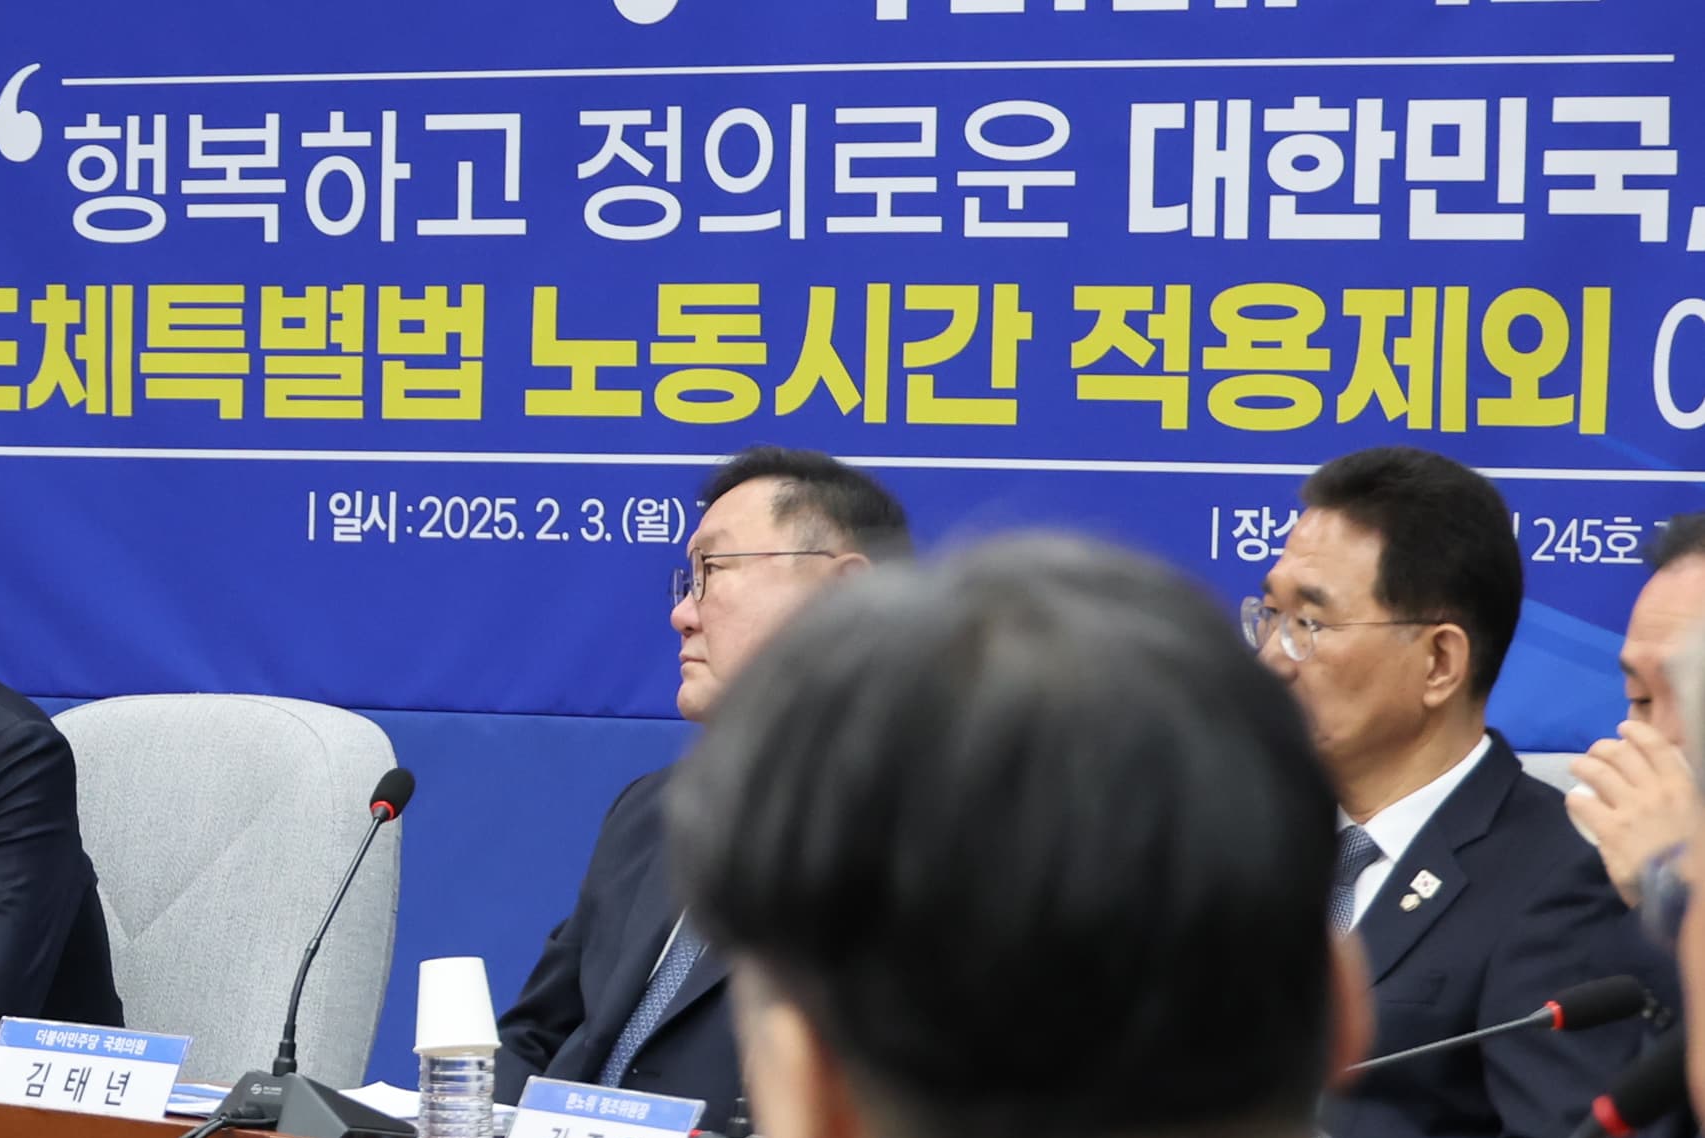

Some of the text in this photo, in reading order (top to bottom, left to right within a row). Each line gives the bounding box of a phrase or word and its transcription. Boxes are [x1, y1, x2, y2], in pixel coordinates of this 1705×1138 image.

[577, 100, 1076, 241] 정의로운
[524, 283, 1033, 425] 노동시간
[1070, 282, 1611, 435] 적용제외
[622, 497, 686, 544] (월)
[1531, 516, 1644, 564] 245호
[35, 1029, 148, 1056] 더불어민주당 국회의원
